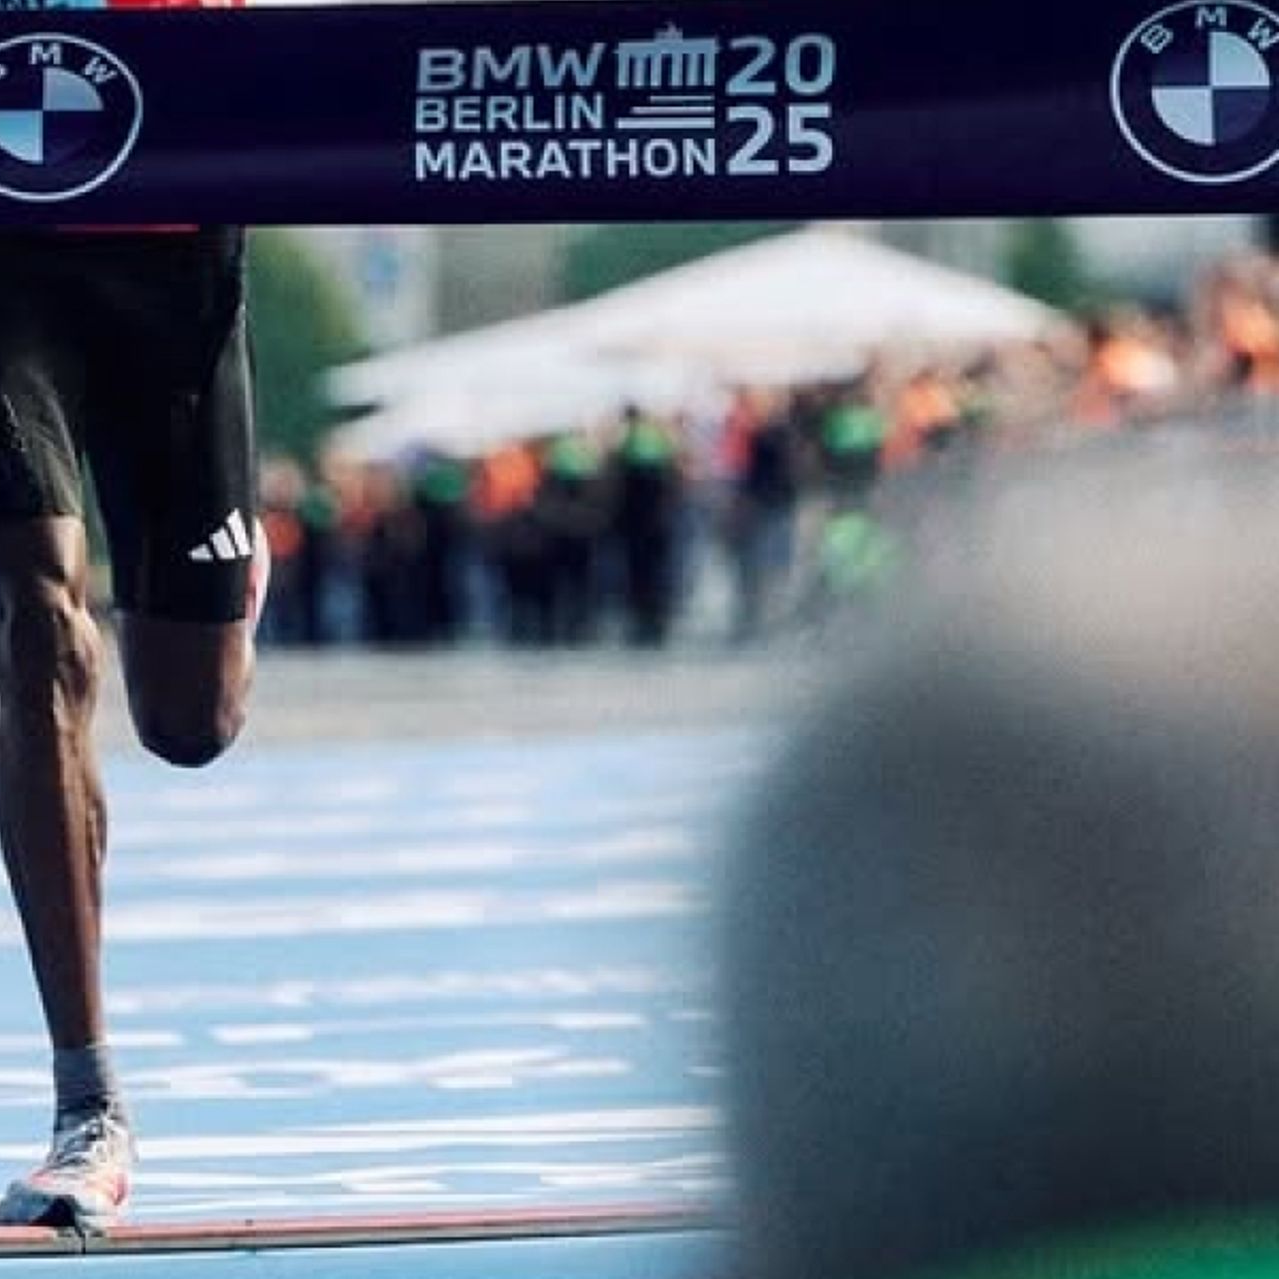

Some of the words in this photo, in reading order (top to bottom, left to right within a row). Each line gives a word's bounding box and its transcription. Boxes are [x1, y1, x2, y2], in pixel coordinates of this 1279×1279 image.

[417, 41, 605, 91] BMW
[725, 34, 837, 96] 20
[415, 93, 604, 133] BERLIN
[415, 138, 716, 181] MARATHON
[727, 103, 834, 175] 25
